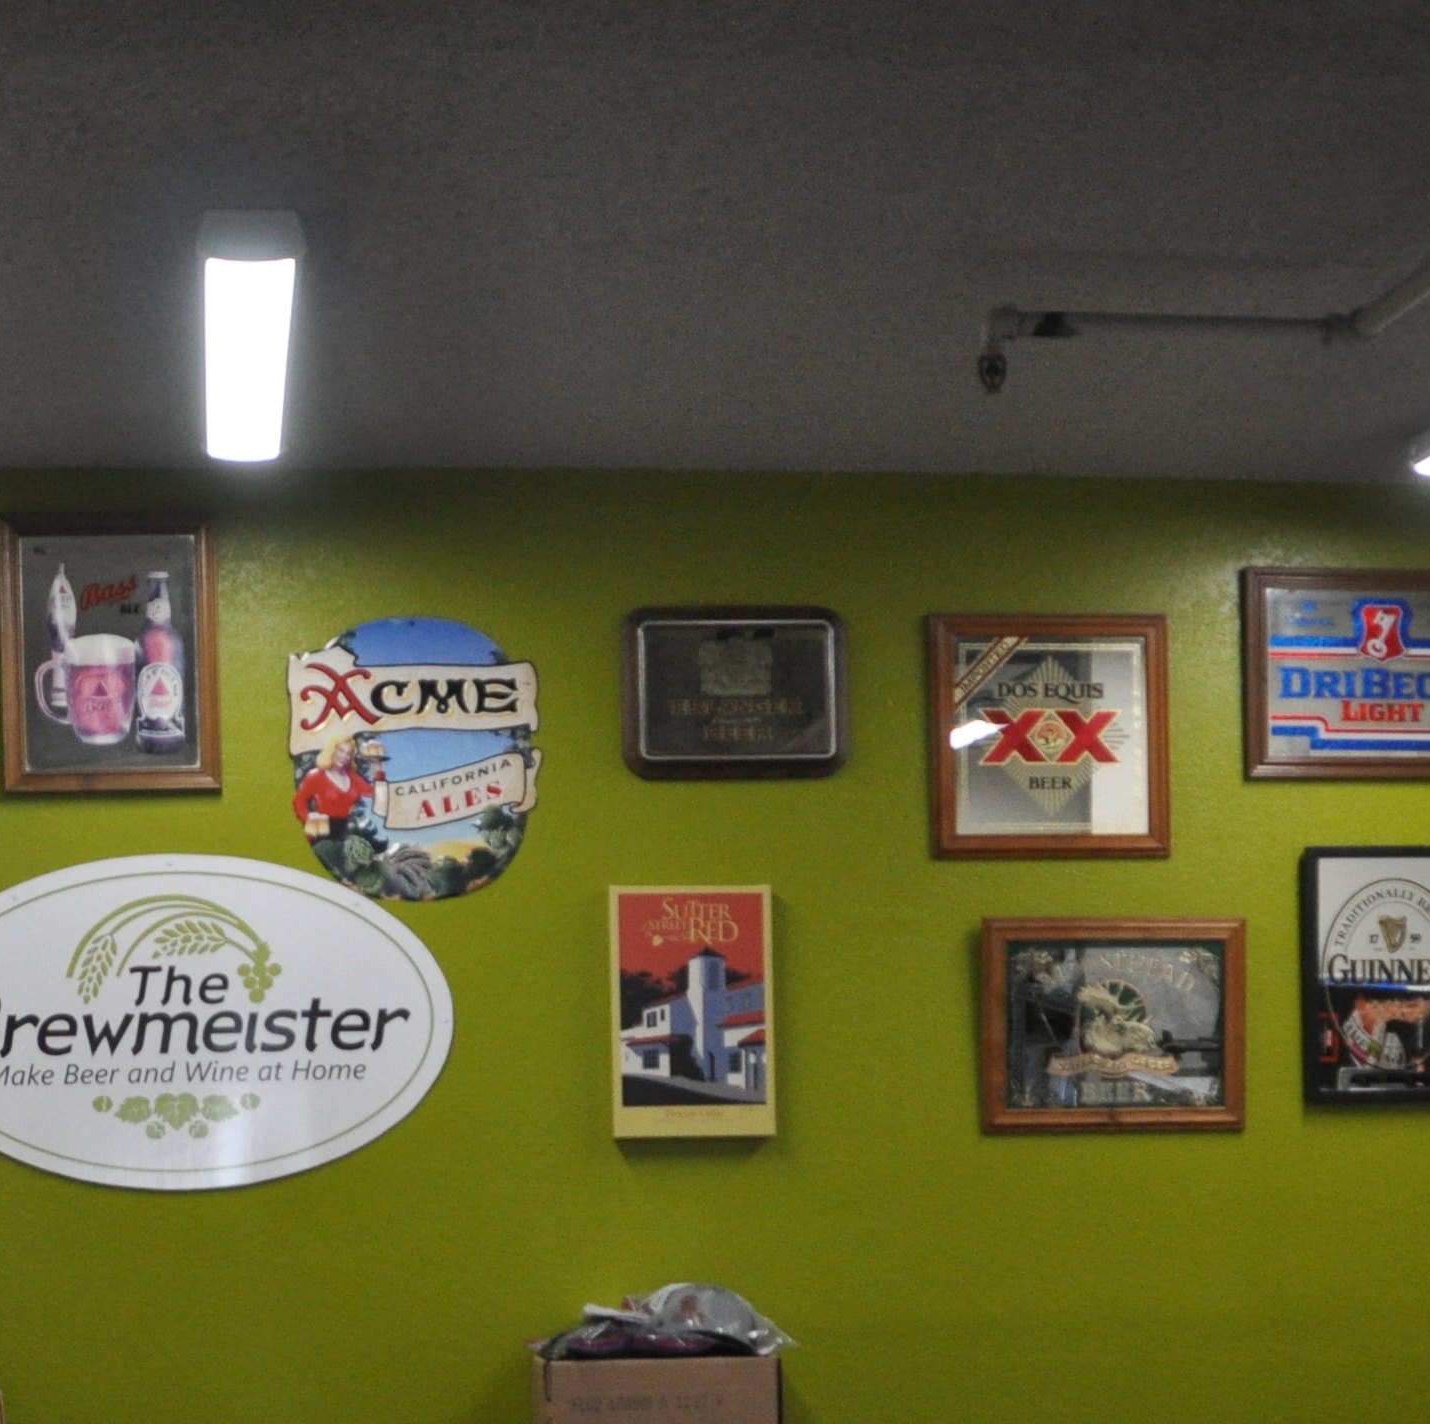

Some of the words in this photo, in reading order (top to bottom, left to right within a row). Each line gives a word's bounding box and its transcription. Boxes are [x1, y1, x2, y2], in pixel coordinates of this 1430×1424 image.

[80, 574, 138, 612] Bass
[121, 602, 140, 614] ALE
[300, 662, 520, 731] ACME
[997, 682, 1037, 699] DOS
[1043, 682, 1104, 704] EQUIS
[1342, 700, 1424, 722] LIGHT
[395, 758, 512, 797] CALIFORNIA
[1028, 776, 1073, 791] BEER
[416, 780, 503, 821] ALES
[662, 897, 732, 920] SUTTER
[1335, 886, 1415, 947] TRADITIONALLY
[129, 965, 229, 1006] The
[64, 1062, 120, 1086] Beer
[127, 1060, 174, 1085] and
[185, 1060, 249, 1083] Wine
[257, 1062, 283, 1082] at
[291, 1059, 367, 1082] Home
[1080, 1081, 1153, 1104] BEER
